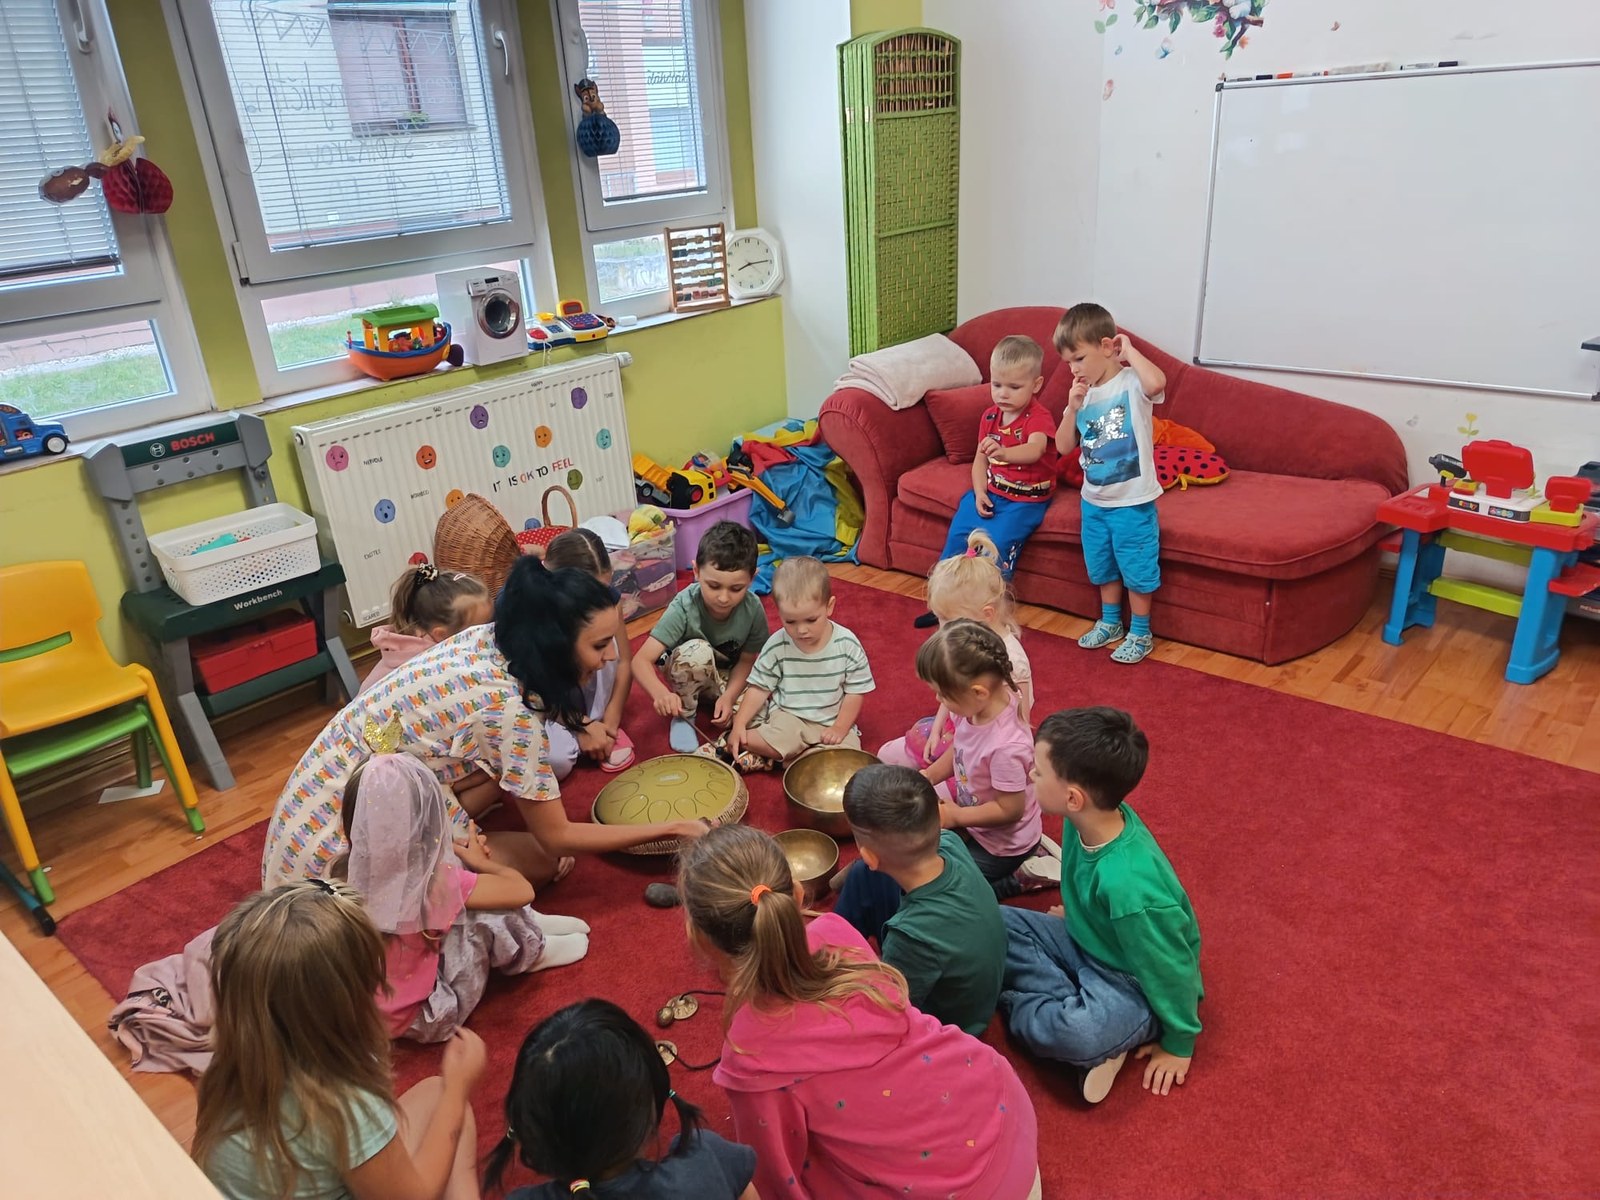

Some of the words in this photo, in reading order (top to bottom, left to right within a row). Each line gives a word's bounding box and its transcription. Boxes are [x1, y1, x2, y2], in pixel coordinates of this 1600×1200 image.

[170, 432, 215, 452] BOSCH
[493, 480, 502, 493] IT
[508, 475, 519, 487] IS
[519, 471, 535, 484] OK
[536, 465, 549, 478] TO
[552, 457, 575, 472] FEEL
[233, 589, 283, 611] Workbench
